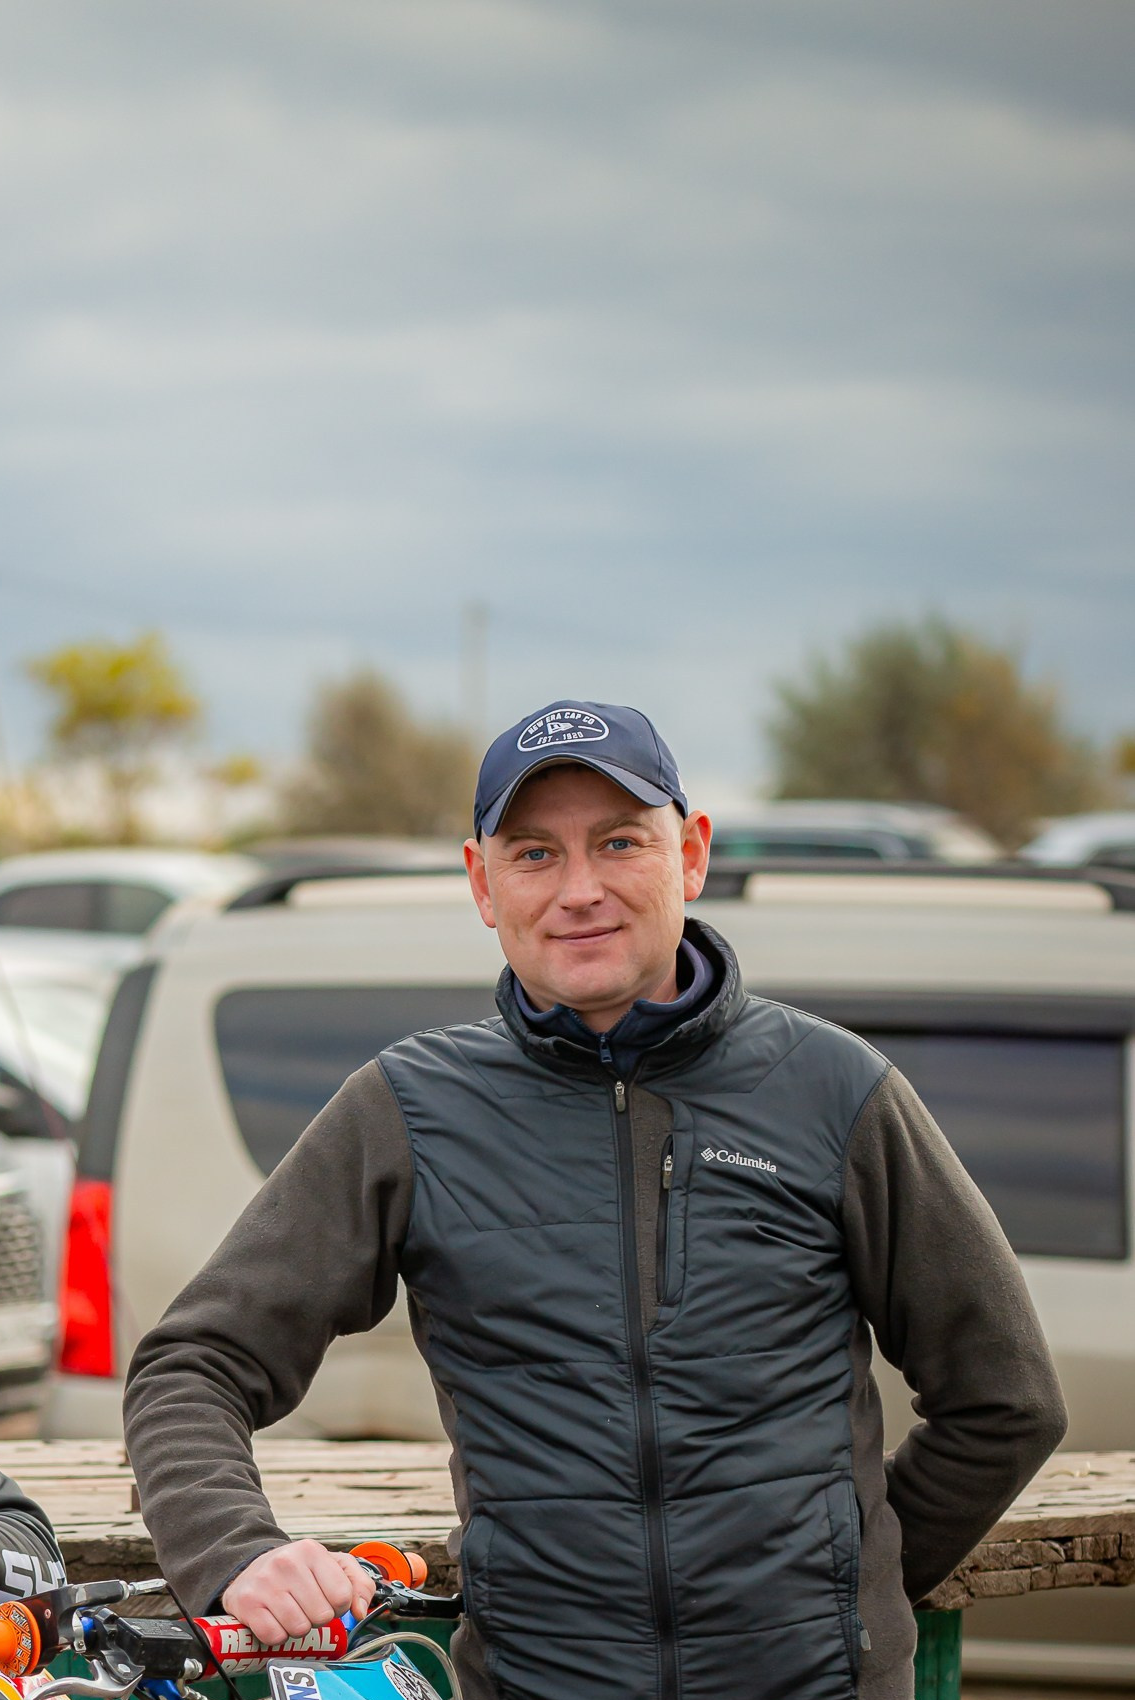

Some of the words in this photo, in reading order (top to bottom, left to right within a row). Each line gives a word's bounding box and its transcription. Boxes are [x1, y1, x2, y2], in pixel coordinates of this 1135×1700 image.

[527, 719, 544, 735] NEW
[545, 712, 562, 723] ERA
[564, 711, 582, 720] CAP
[581, 715, 596, 725] CO
[562, 731, 584, 741] 1920
[716, 1149, 777, 1173] Columbia
